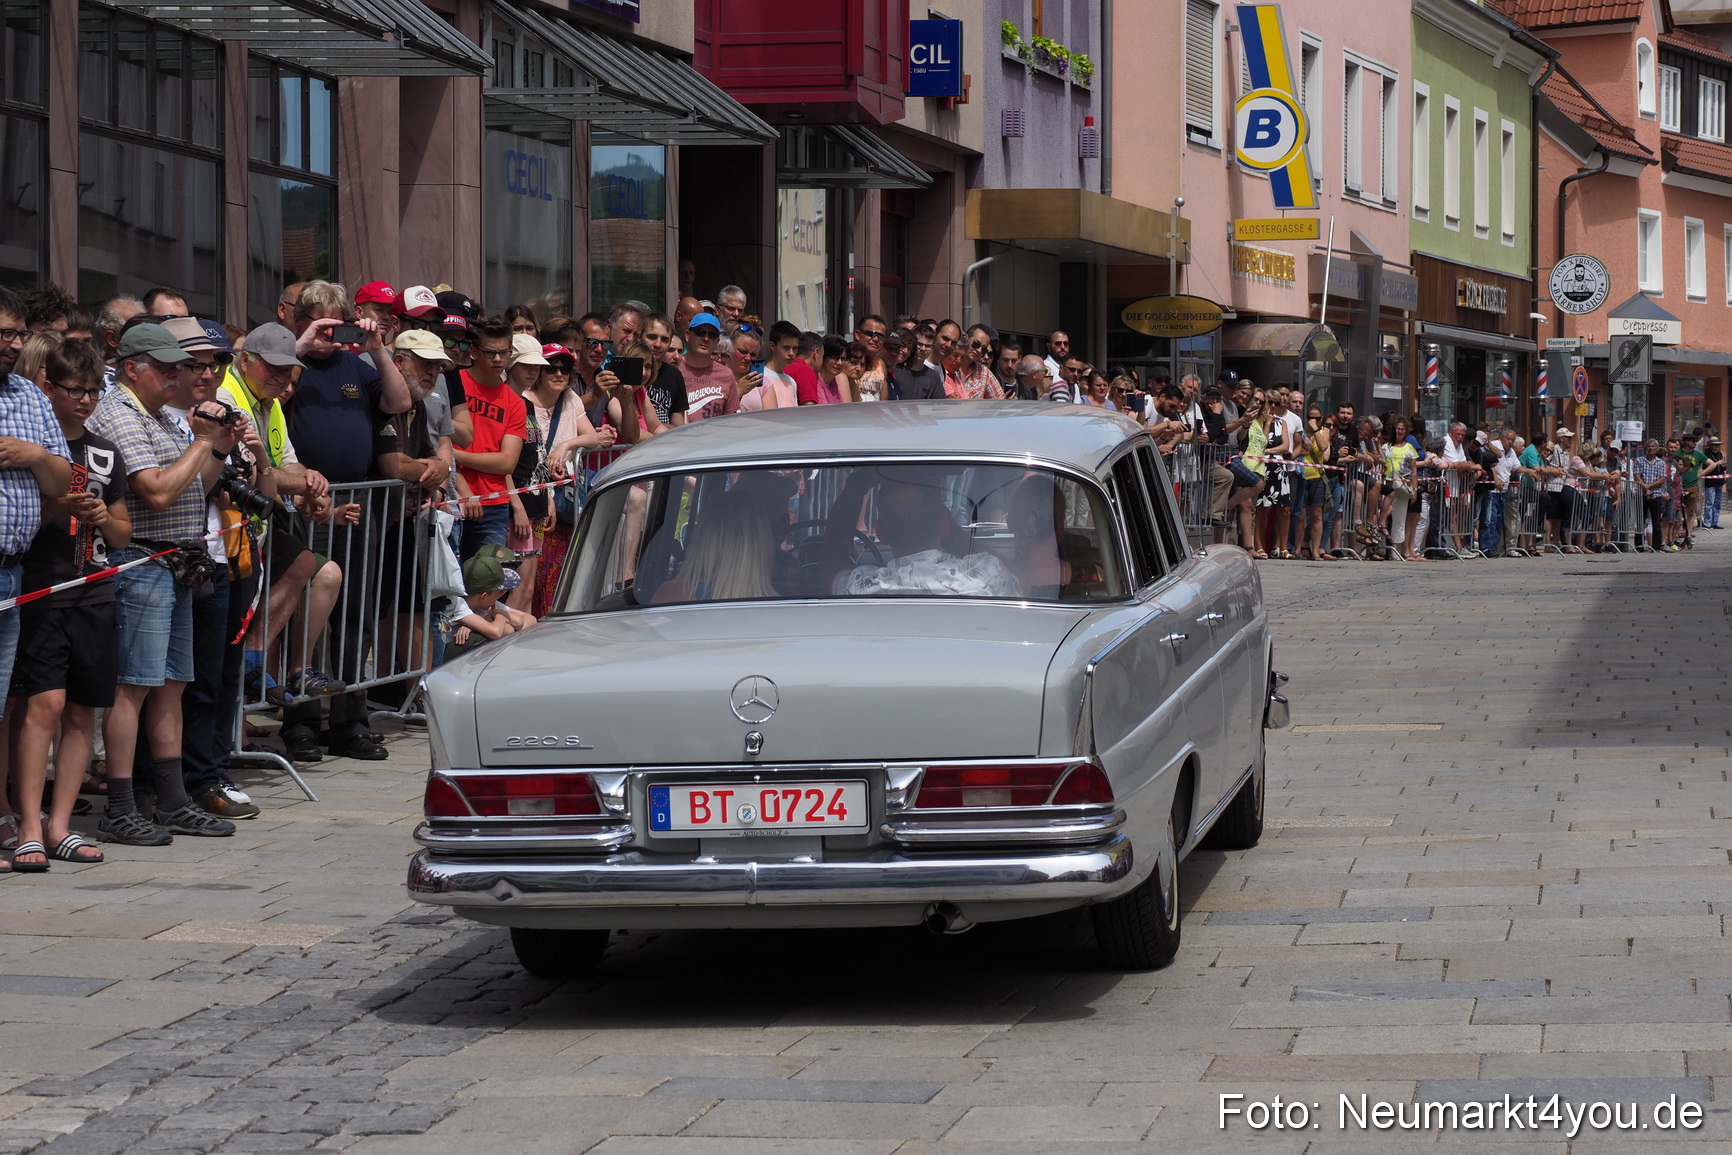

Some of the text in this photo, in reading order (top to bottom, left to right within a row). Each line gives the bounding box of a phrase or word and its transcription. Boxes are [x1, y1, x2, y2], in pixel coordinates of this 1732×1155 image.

[910, 43, 951, 65] CIL
[1243, 109, 1282, 149] B
[505, 149, 553, 201] CECIL
[607, 173, 649, 220] CECIL
[793, 217, 822, 256] CECIL
[1239, 223, 1313, 234] KLOSTERGASSE 4
[1575, 258, 1604, 279] FRISEURE
[1126, 312, 1221, 321] DIE GOLDSCHMIEDE
[1622, 319, 1668, 335] Creppresso
[506, 735, 580, 746] 220 S
[689, 787, 848, 824] BT 0724
[657, 812, 666, 823] D
